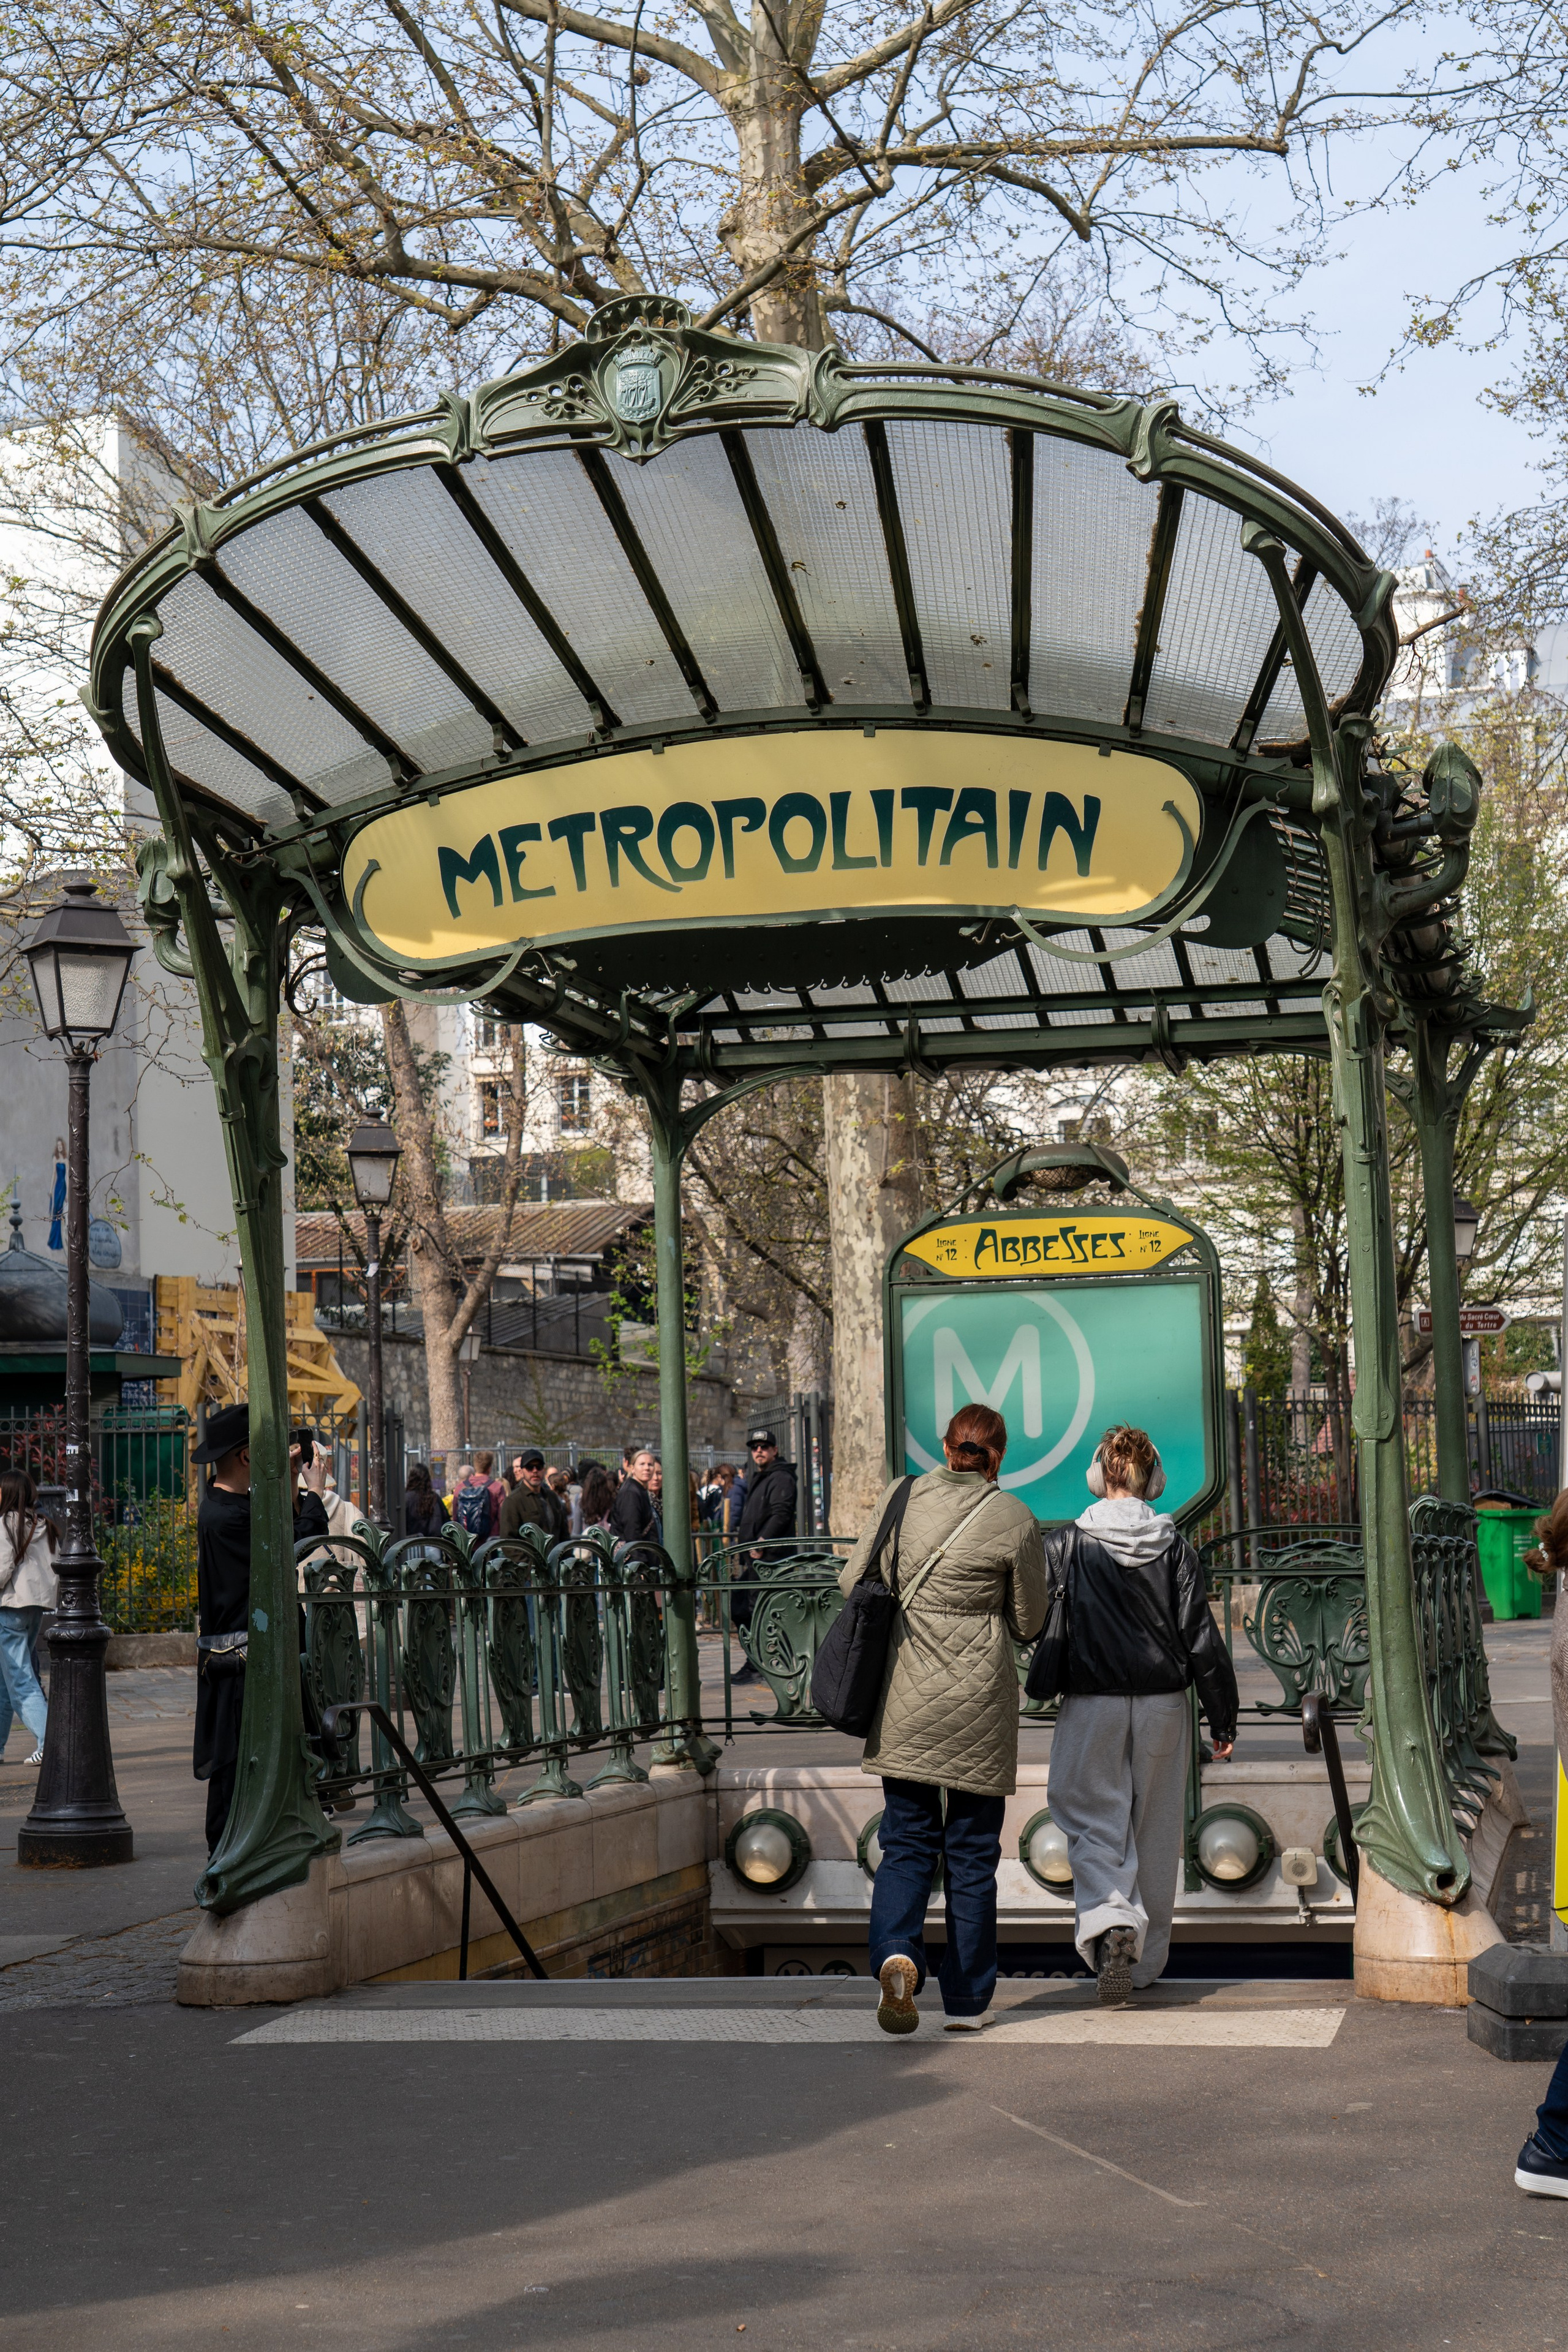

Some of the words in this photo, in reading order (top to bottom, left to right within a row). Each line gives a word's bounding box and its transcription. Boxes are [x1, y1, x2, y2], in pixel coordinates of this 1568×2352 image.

[437, 785, 1101, 919] METROPOLITAIN
[1139, 1229, 1159, 1239] LIGNE
[937, 1238, 957, 1248] LIGNE
[974, 1226, 1126, 1270] ABBESSES
[1148, 1240, 1161, 1253] 12
[944, 1248, 957, 1261] 12
[933, 1324, 1042, 1439] M
